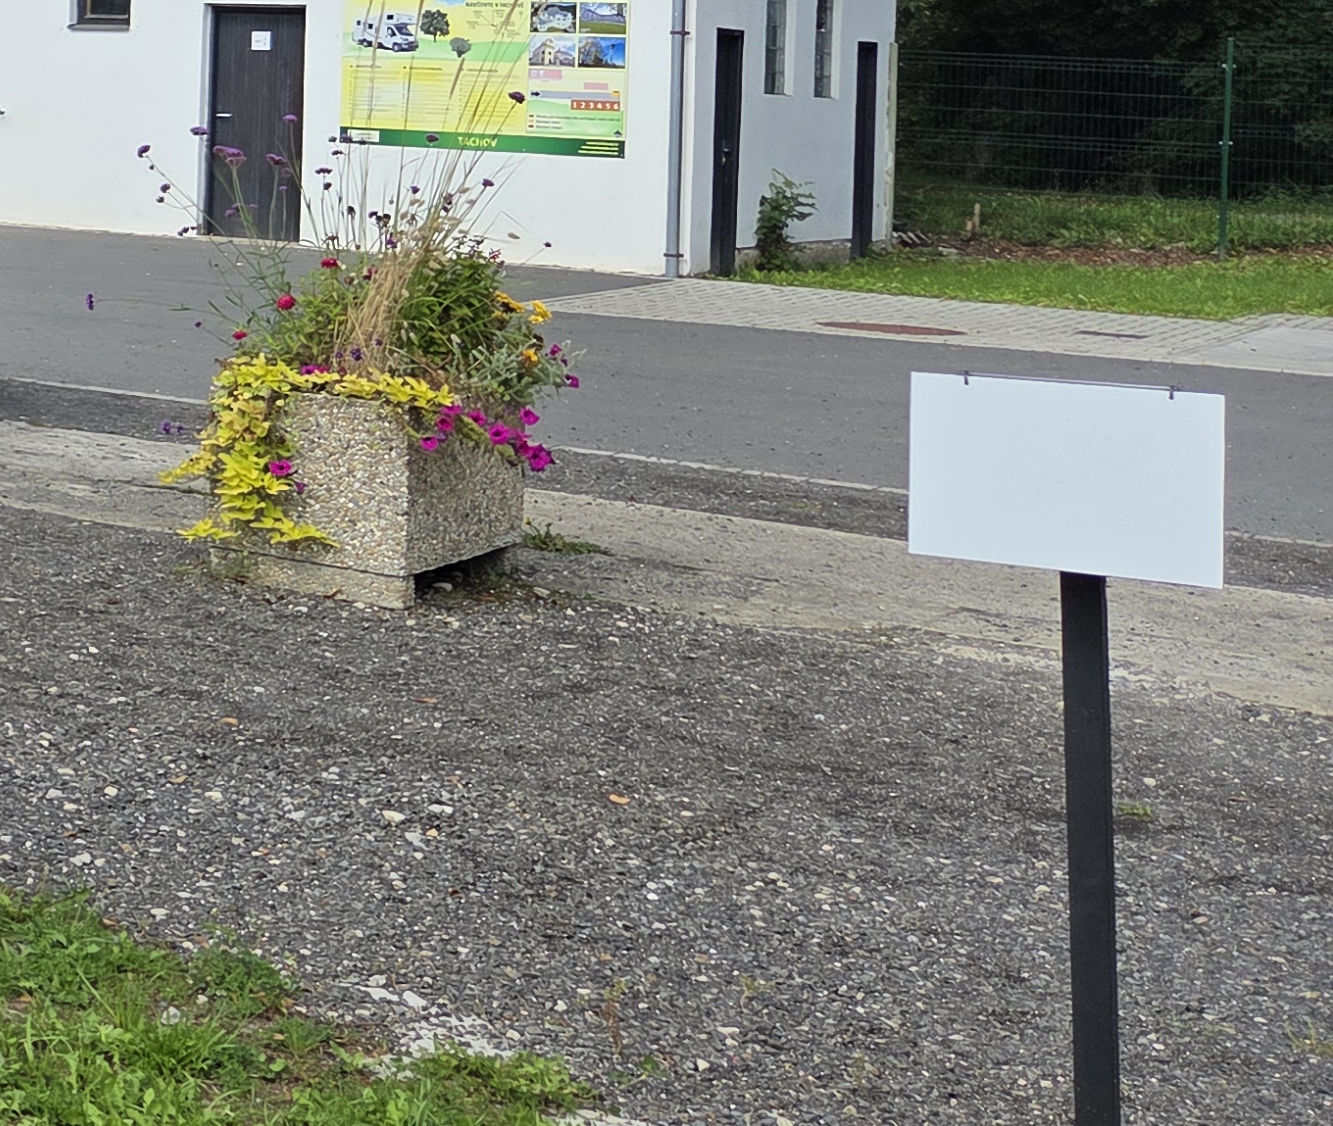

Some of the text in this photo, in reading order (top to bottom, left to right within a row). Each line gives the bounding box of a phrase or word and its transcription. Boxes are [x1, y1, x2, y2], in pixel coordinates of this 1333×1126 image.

[572, 101, 619, 111] 1 2 3 4 5 6
